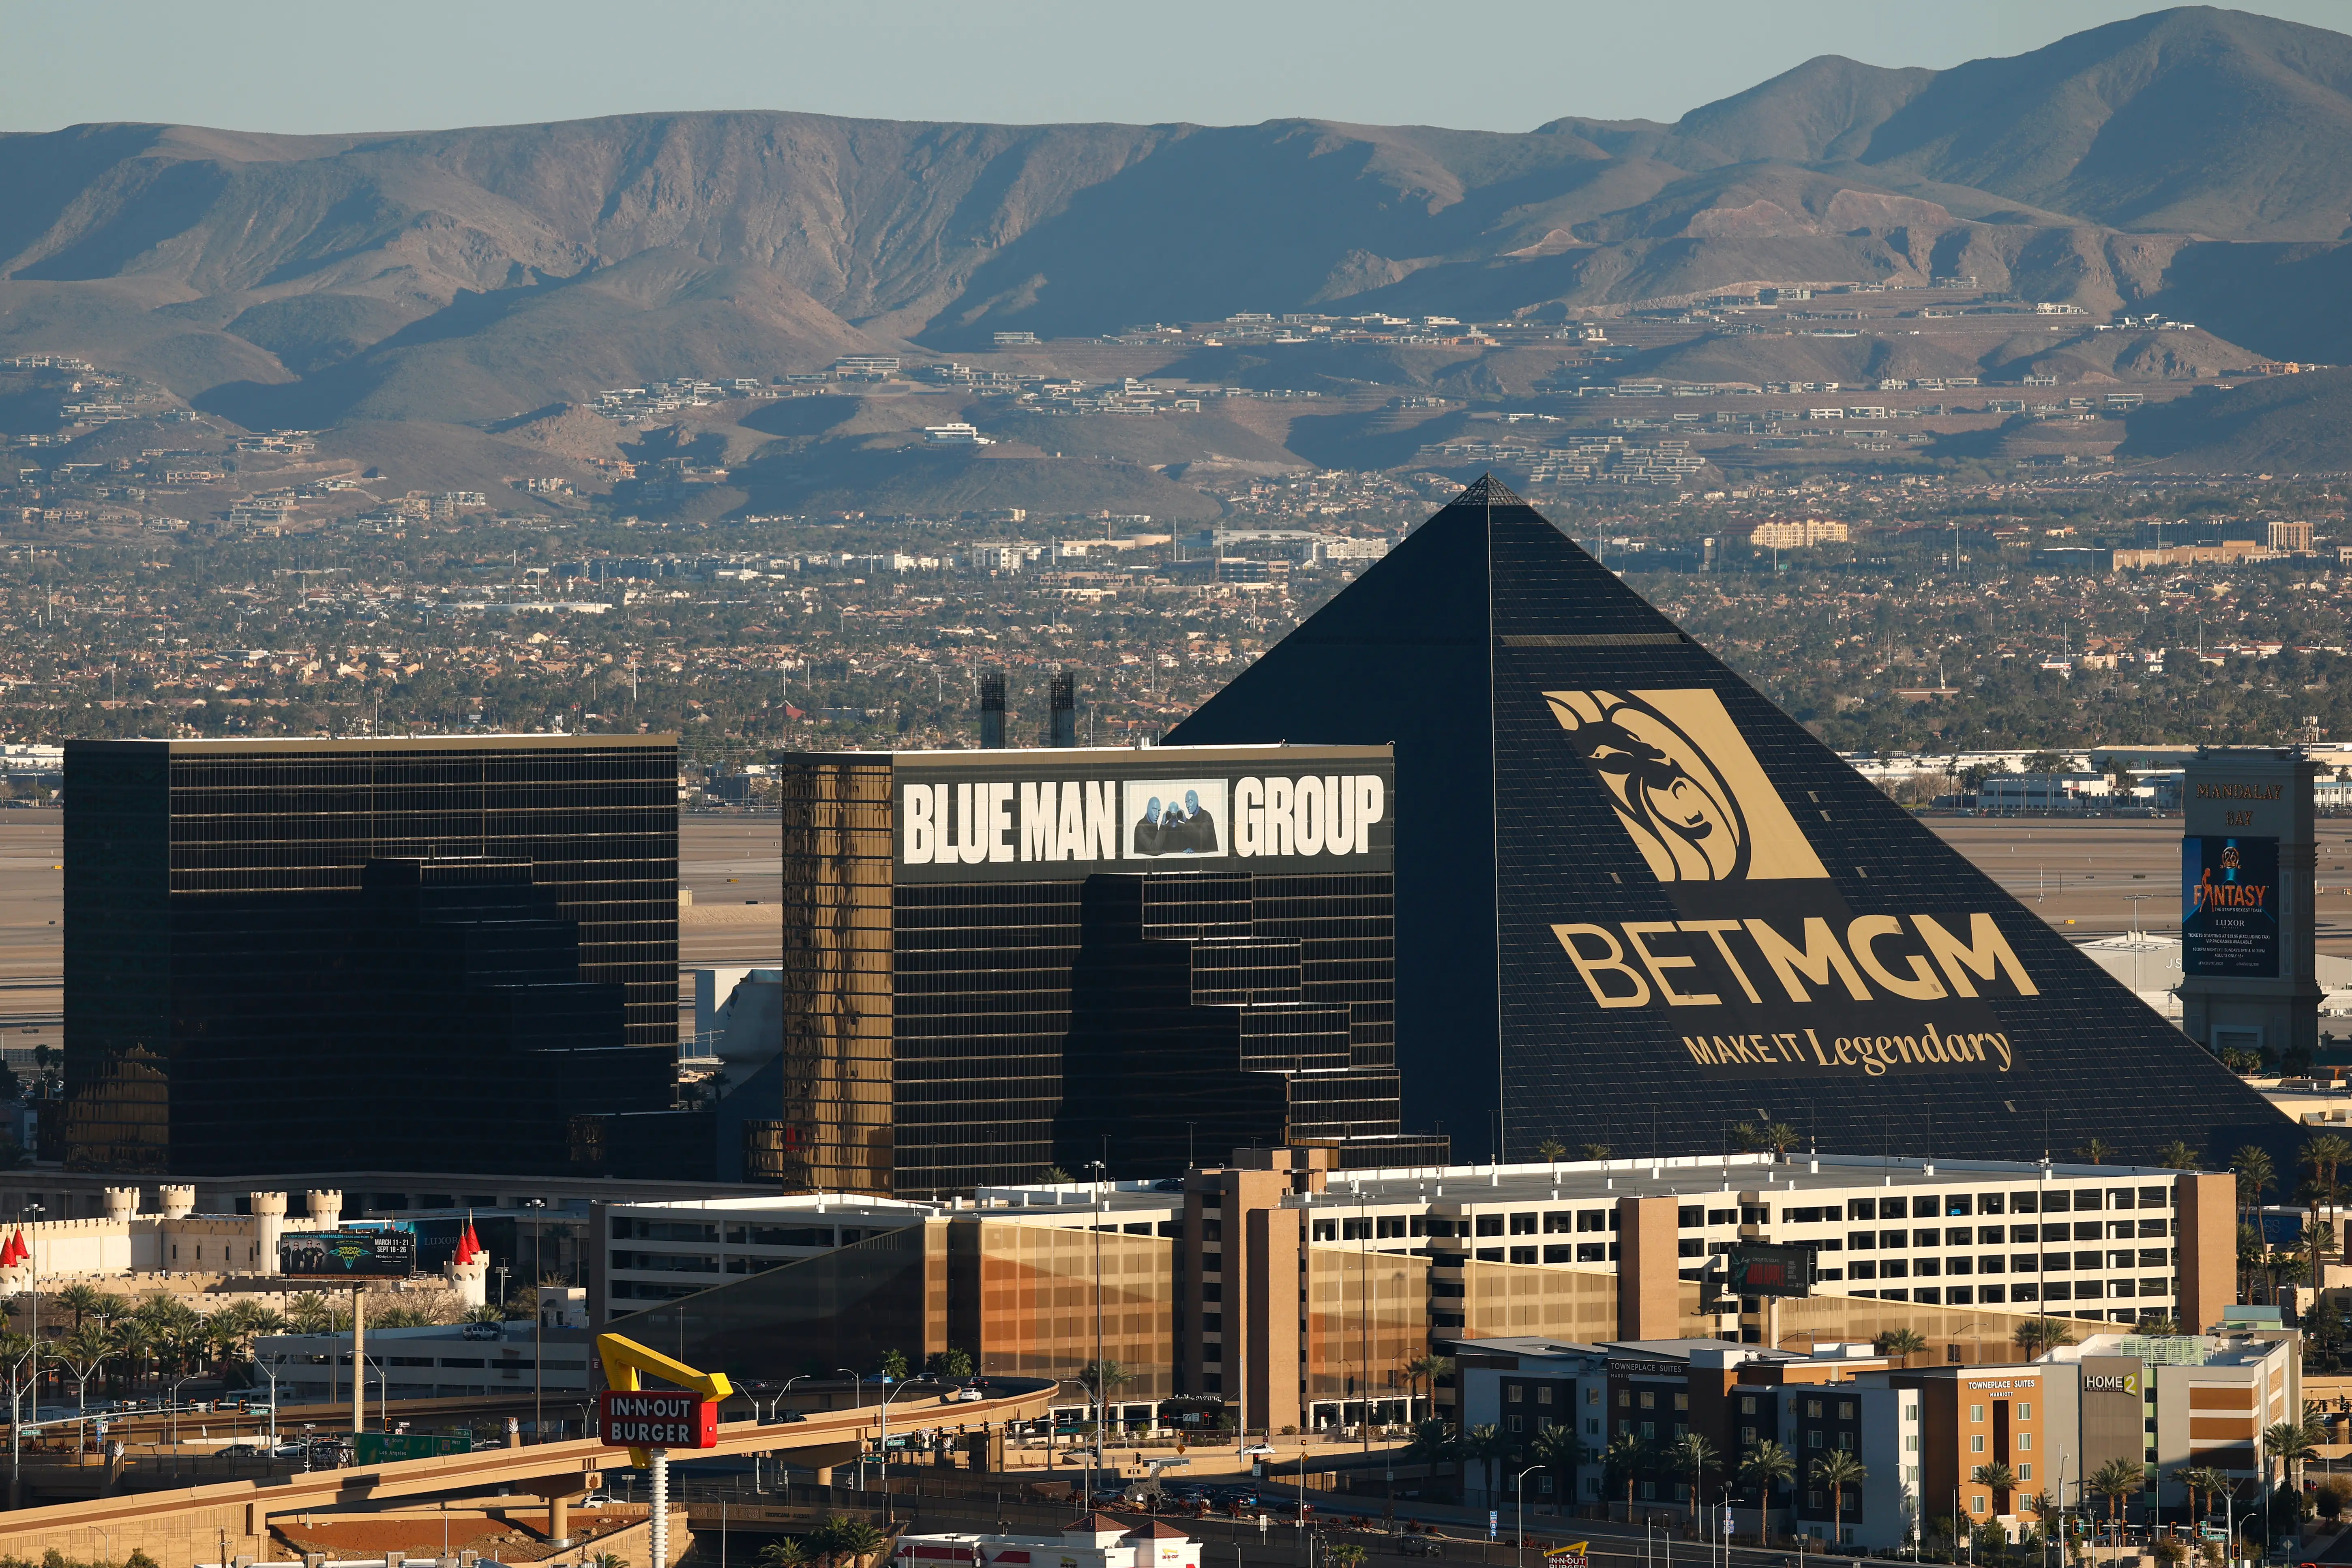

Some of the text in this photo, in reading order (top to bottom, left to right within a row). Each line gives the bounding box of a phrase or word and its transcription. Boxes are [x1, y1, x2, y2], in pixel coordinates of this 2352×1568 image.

[2196, 783, 2283, 800] MANDALAY
[904, 775, 1384, 864] BLUE MAN GROUP
[2225, 811, 2253, 826] BAY
[2224, 851, 2236, 862] 26
[1550, 914, 2040, 1008] BETMGM
[1682, 1023, 2011, 1075] MAKE IT Legendary
[2250, 1218, 2280, 1233] OSIS
[425, 1237, 458, 1245] LUXOR
[1747, 1263, 1785, 1286] MAD APPLE
[1611, 1362, 1655, 1371] TOWNEPLACE
[1968, 1380, 2035, 1390] TOWNEPLACE SUITES
[611, 1422, 690, 1442] BURGER
